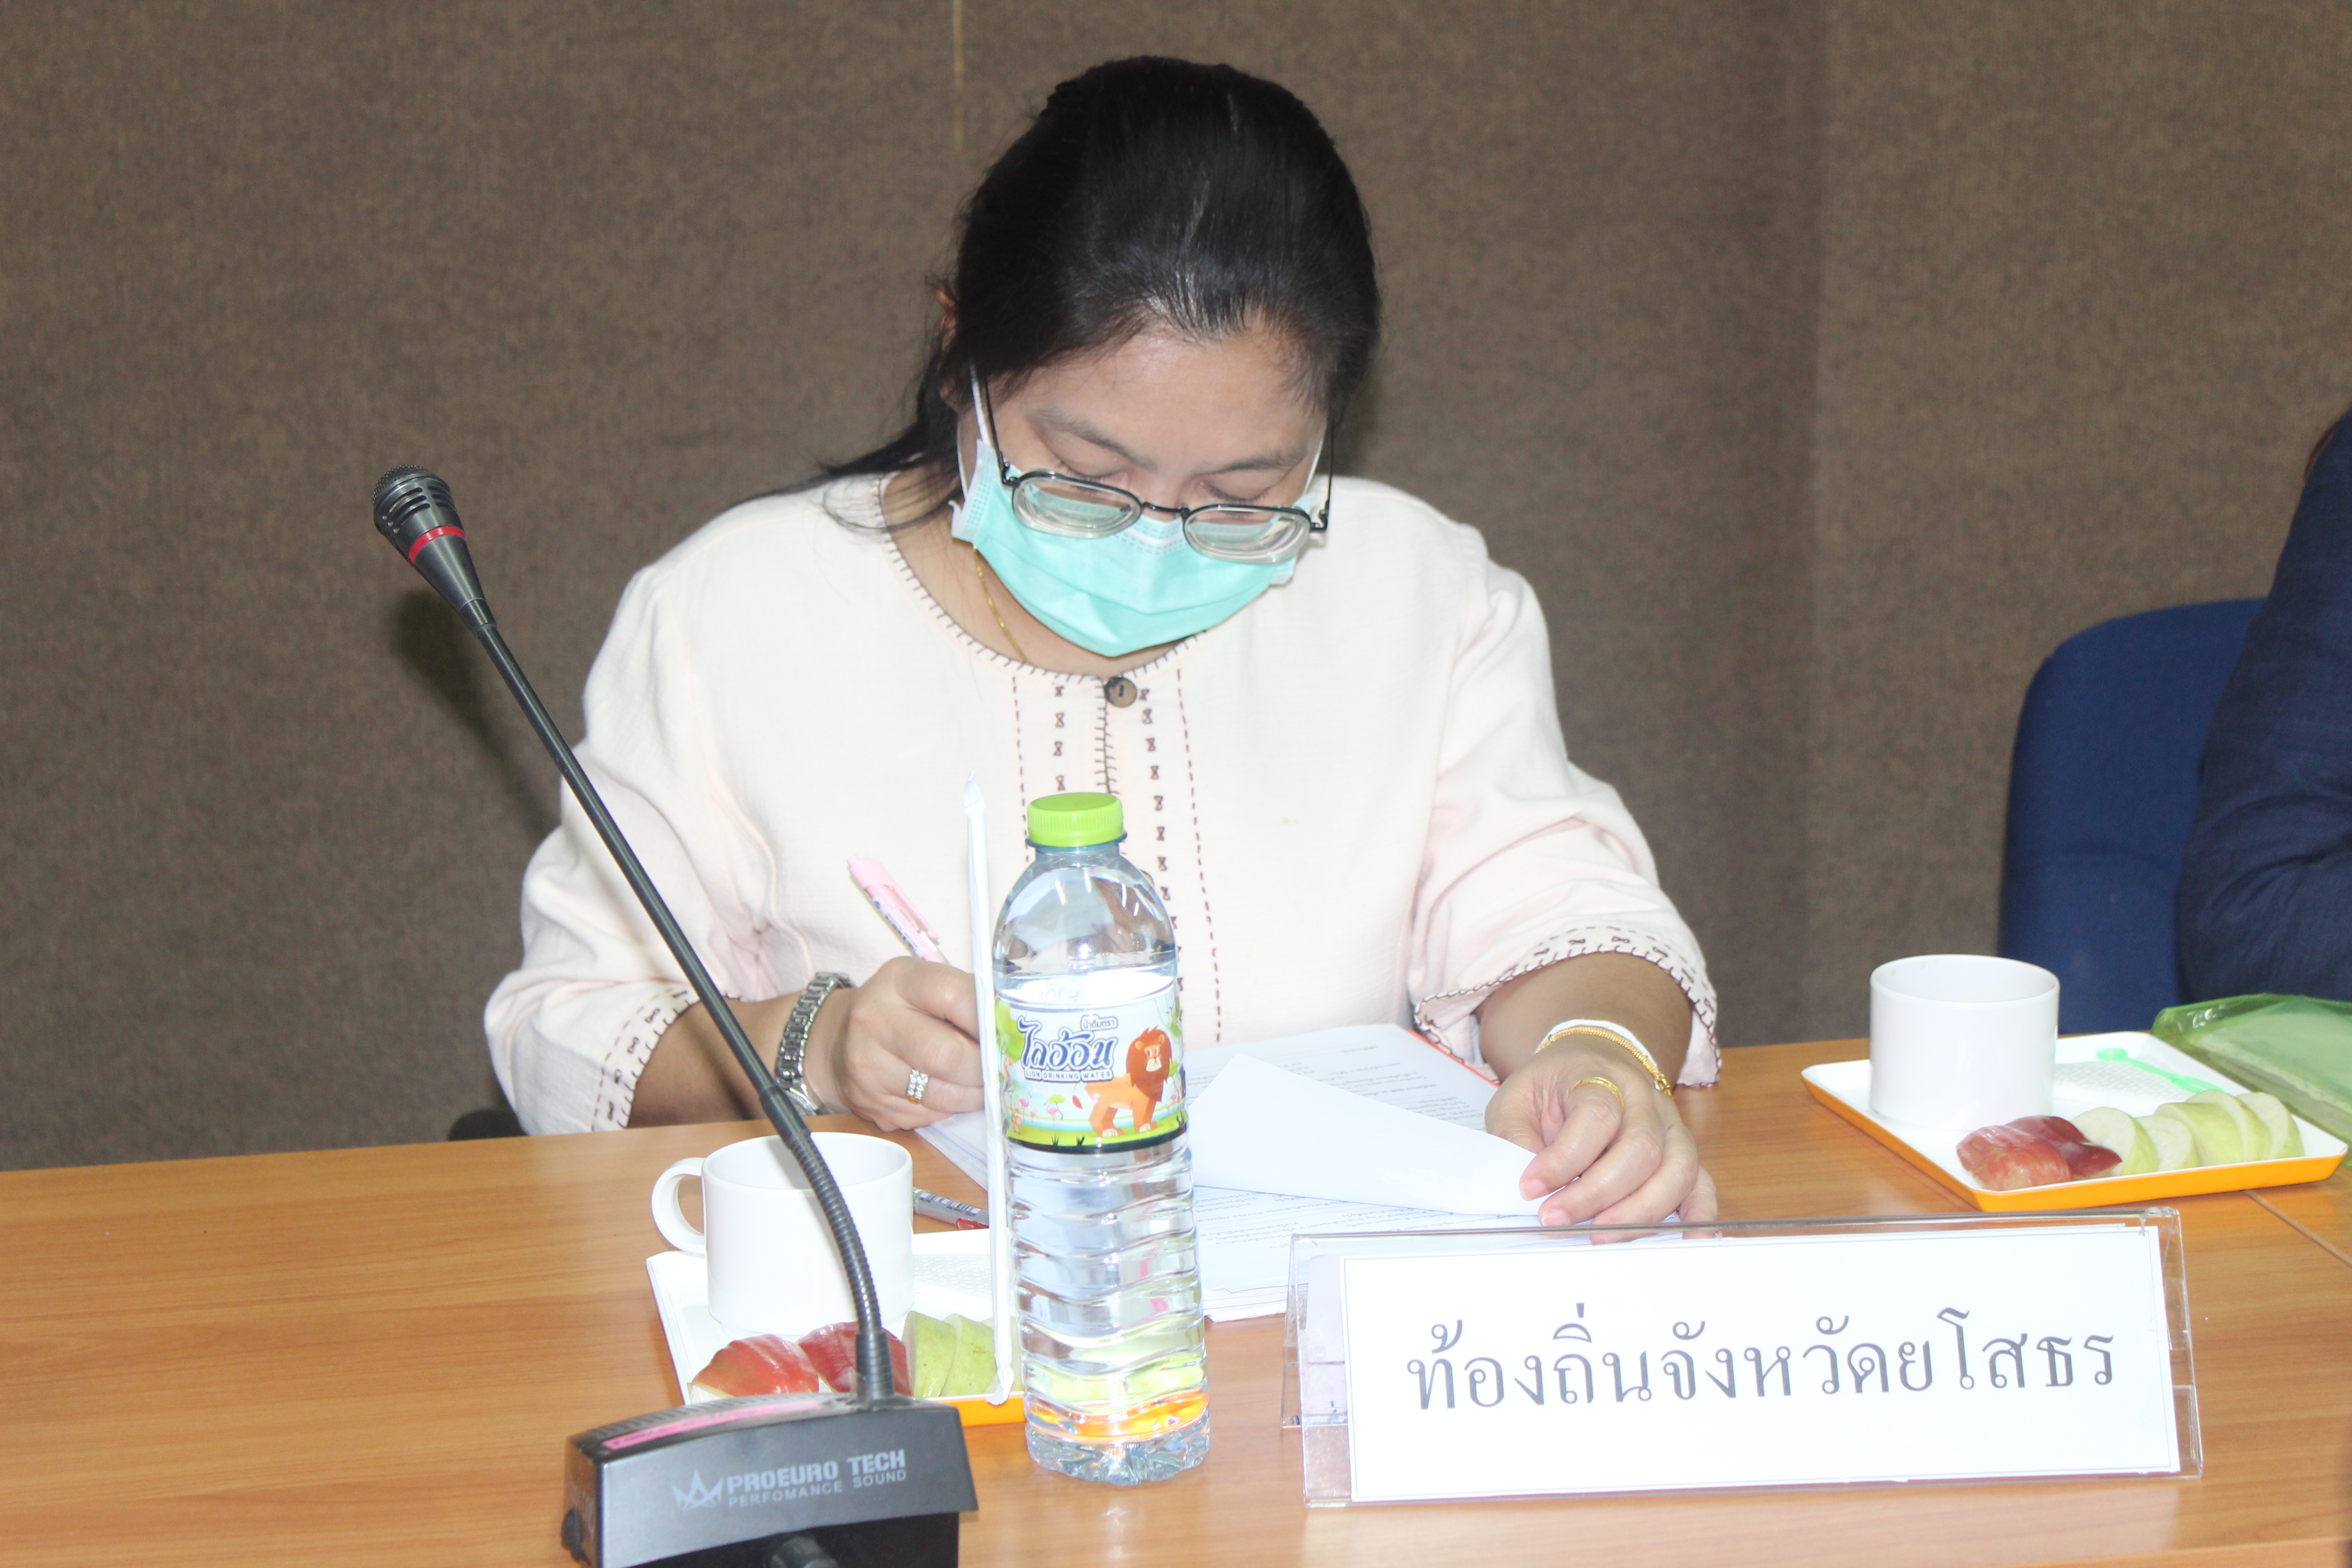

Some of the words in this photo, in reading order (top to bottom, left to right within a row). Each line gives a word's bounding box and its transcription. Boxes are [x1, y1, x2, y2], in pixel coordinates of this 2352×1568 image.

[1018, 1017, 1116, 1068] ไลอ้อน
[1083, 1017, 1115, 1029] น้ำดมตรา
[1025, 1069, 1040, 1078] LION
[1043, 1071, 1079, 1080] DRINKING
[1083, 1071, 1111, 1079] WATER
[1406, 1302, 2114, 1410] ท้องถิ่นจังหวัดยโสธร
[726, 1460, 839, 1495] PROEURO
[846, 1448, 906, 1476] TECH
[728, 1480, 844, 1509] PERFOMANCE
[852, 1469, 907, 1489] SOUND
